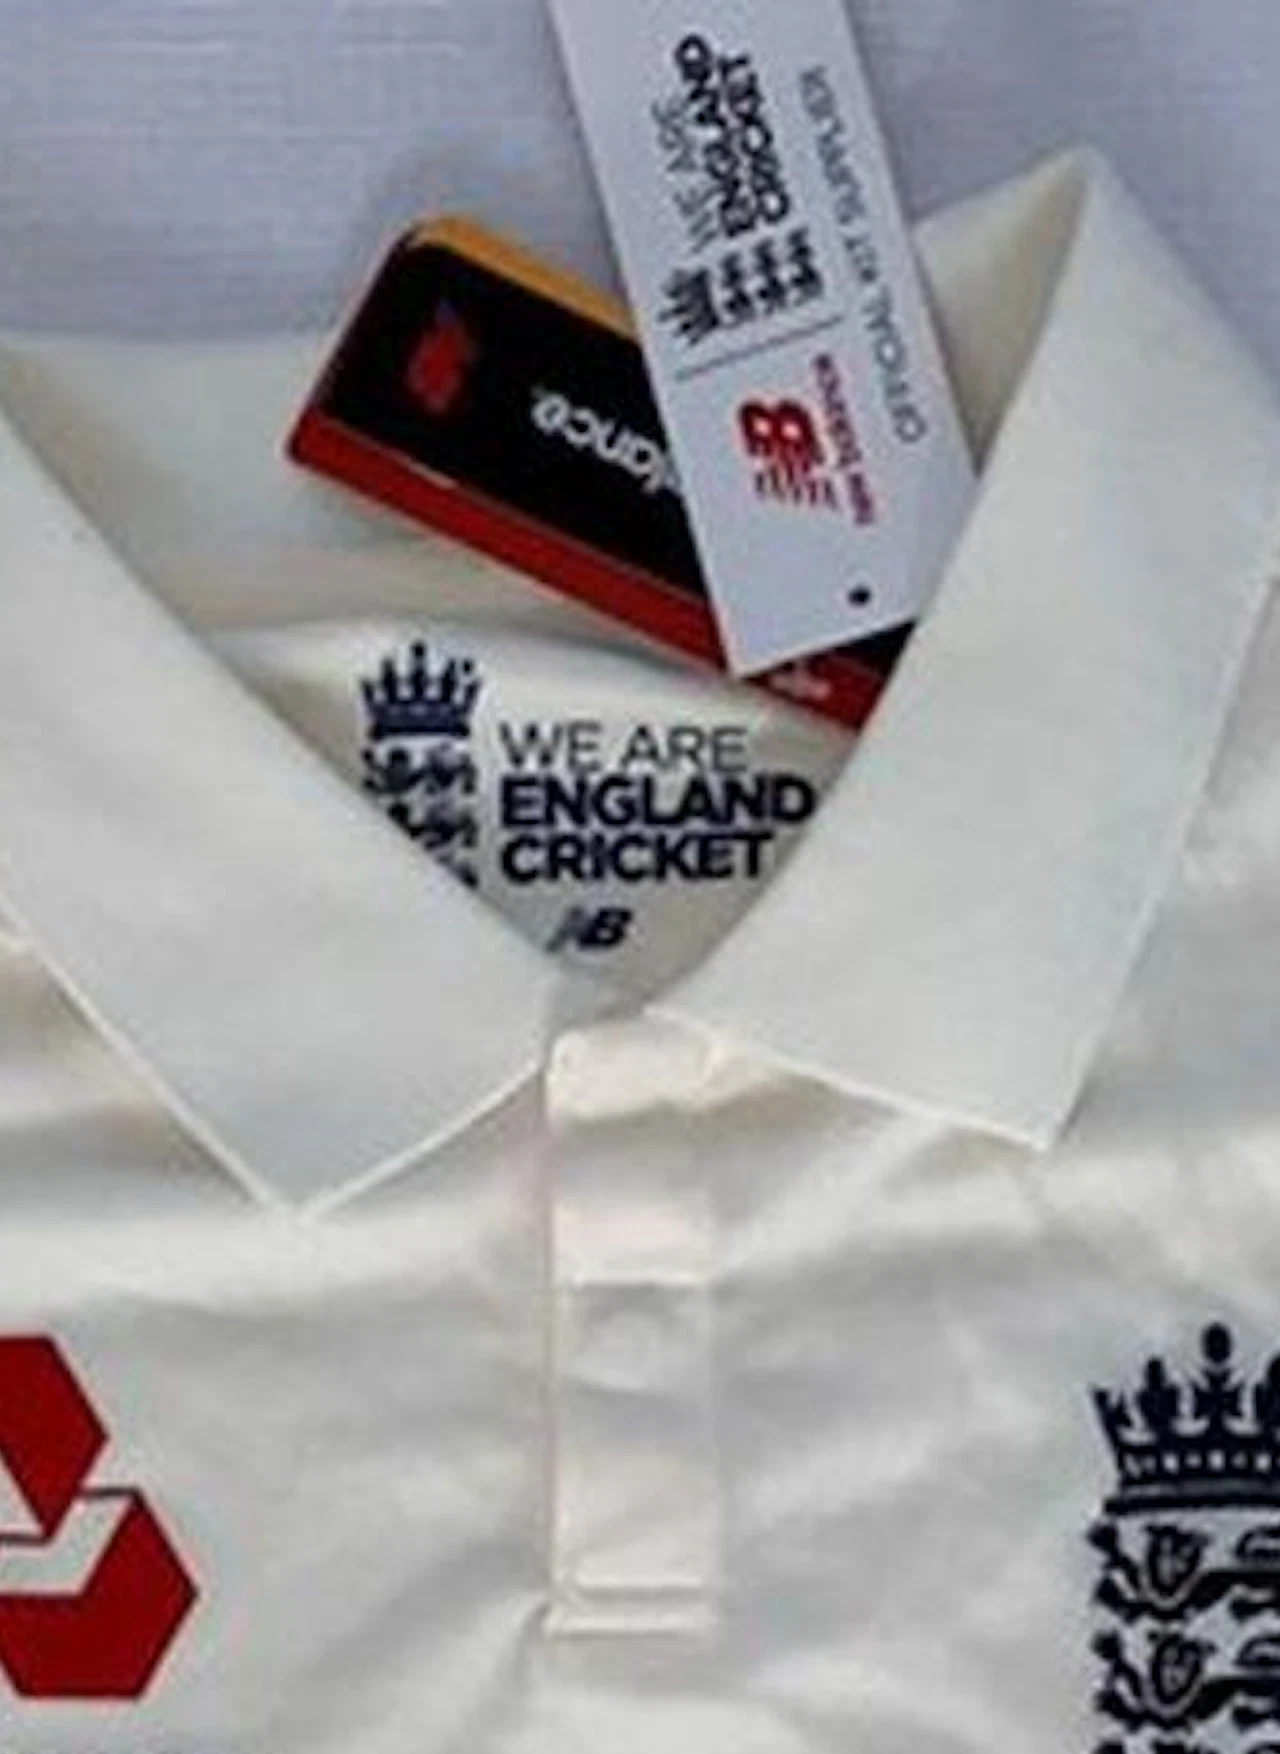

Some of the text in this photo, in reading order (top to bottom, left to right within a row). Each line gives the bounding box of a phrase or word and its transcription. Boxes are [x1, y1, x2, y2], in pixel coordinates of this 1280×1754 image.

[674, 34, 757, 238] ENGLAND
[718, 54, 790, 225] CRICKET
[530, 390, 686, 494] lance
[500, 720, 749, 774] WE ARE
[500, 773, 817, 828] ENGLAND
[500, 830, 775, 885] CRICKET
